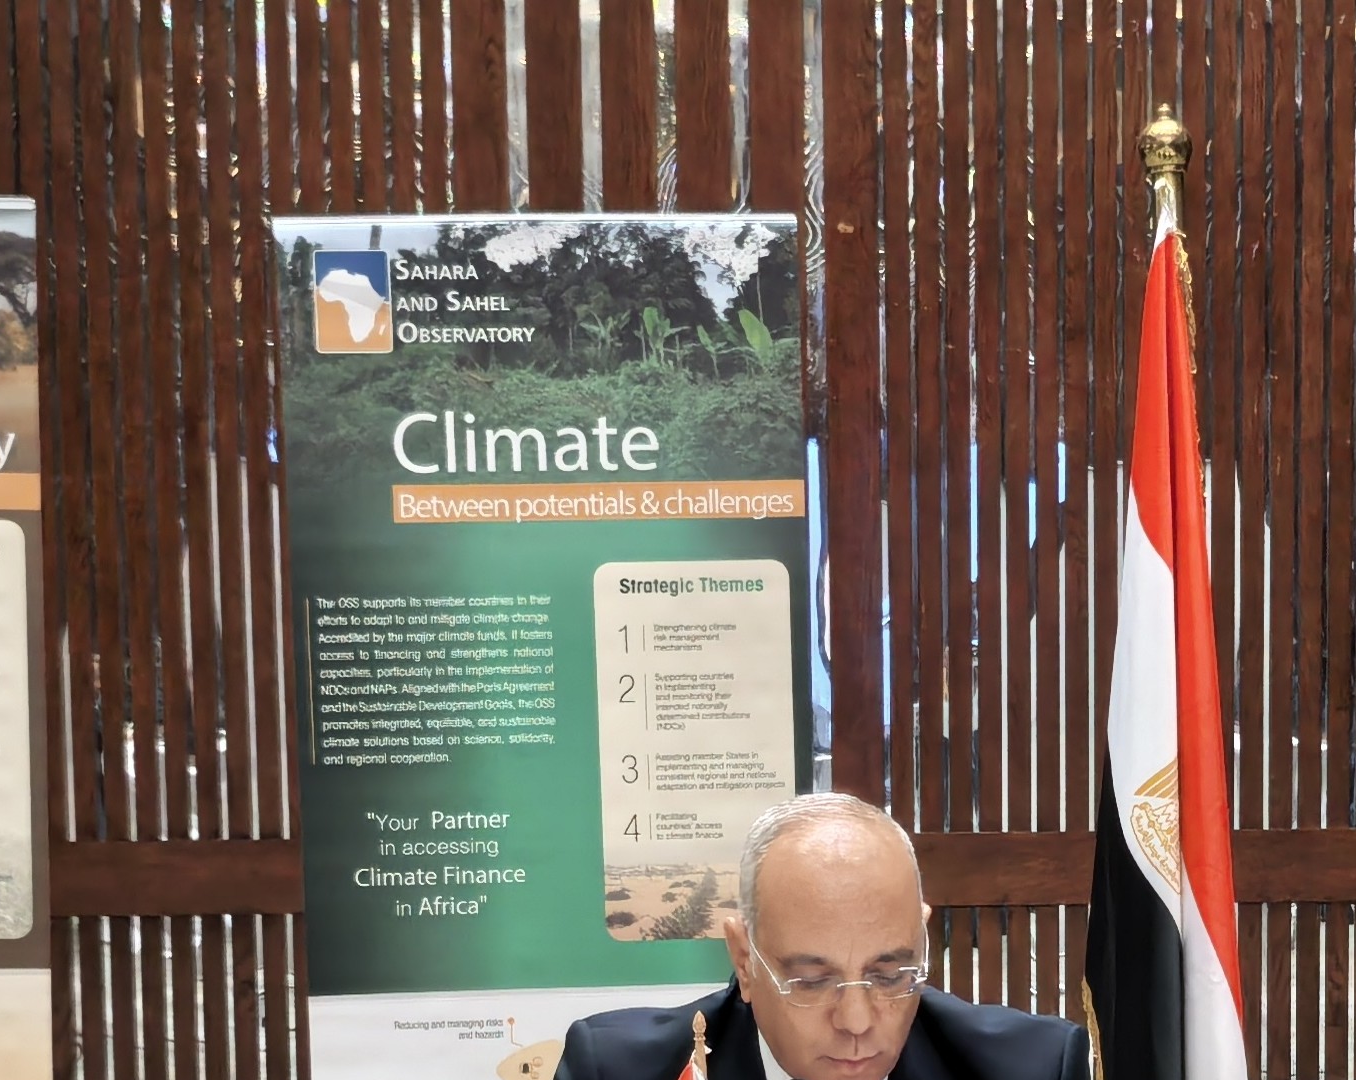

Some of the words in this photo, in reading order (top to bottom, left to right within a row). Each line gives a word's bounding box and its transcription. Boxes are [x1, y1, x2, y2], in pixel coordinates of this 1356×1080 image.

[393, 410, 659, 474] Climate
[399, 492, 509, 519] Between
[514, 491, 636, 523] potentials
[641, 491, 660, 514] &
[664, 490, 793, 520] challenges
[620, 578, 694, 596] Strategic
[699, 578, 763, 592] Themes
[619, 625, 628, 653] 1
[619, 675, 636, 703] 2
[364, 735, 409, 747] solutions
[413, 735, 443, 745] based
[324, 754, 343, 765] and
[347, 753, 387, 766] regional
[622, 755, 639, 784] 3
[367, 812, 419, 831] "Your
[432, 811, 510, 830] Partner
[624, 814, 640, 842] 4
[380, 840, 396, 855] in
[402, 838, 498, 857] accessing
[354, 868, 437, 887] Climate
[443, 867, 526, 885] Finance
[397, 901, 411, 916] in
[419, 896, 487, 916] Africa"
[395, 1020, 429, 1030] Reducing
[431, 1020, 445, 1029] and
[447, 1019, 484, 1030] managing
